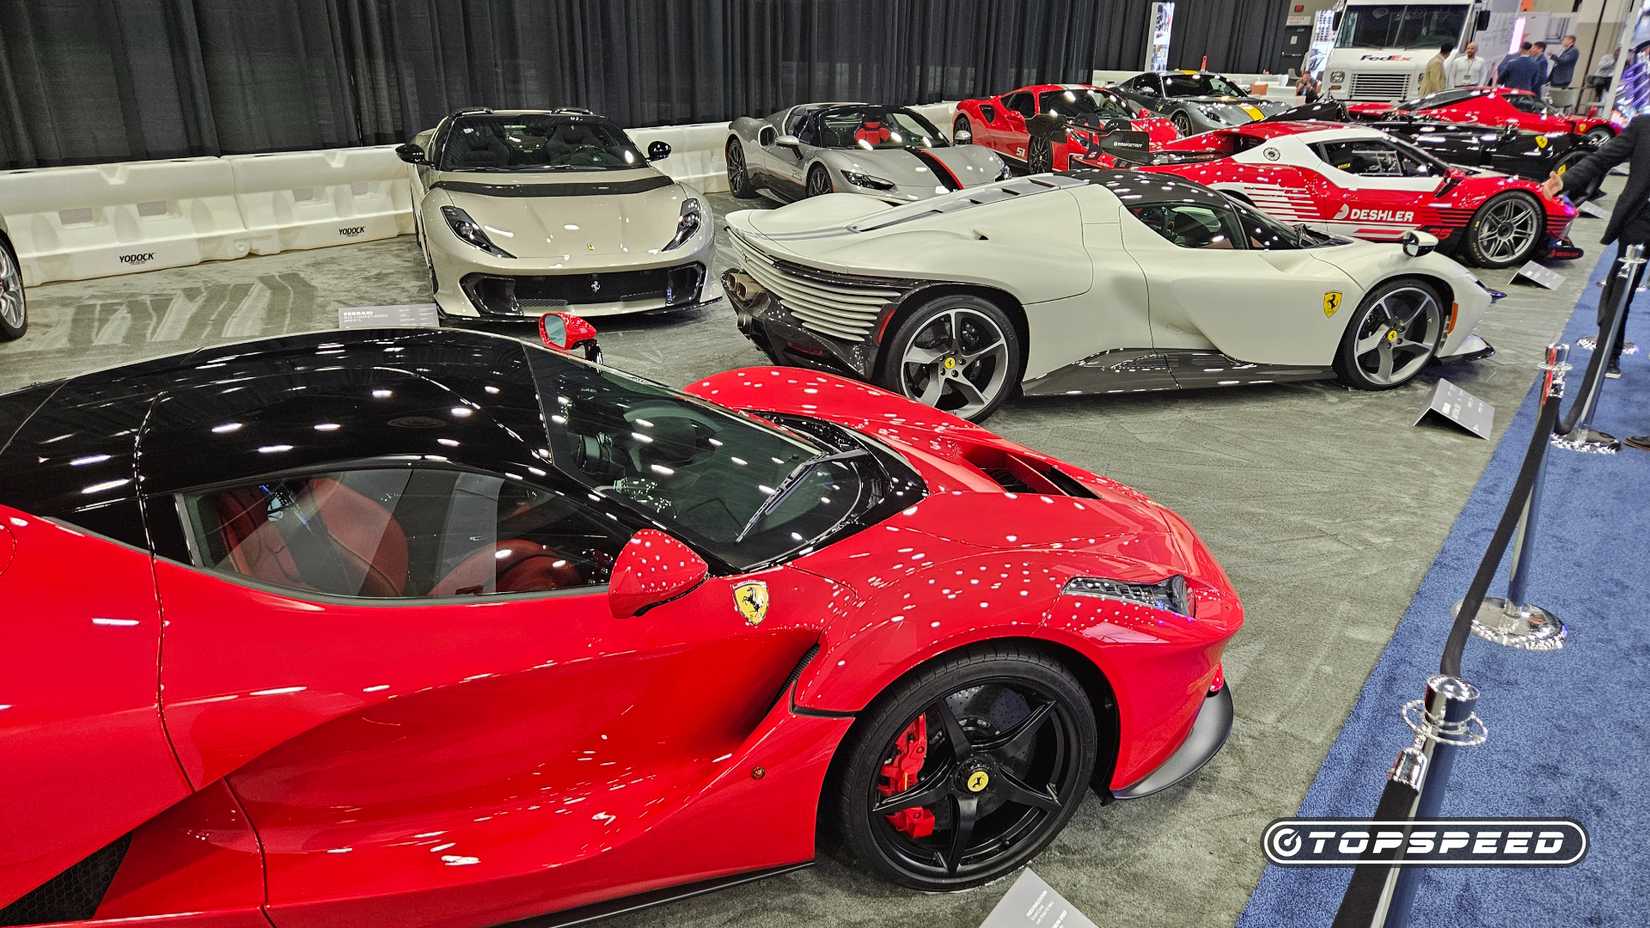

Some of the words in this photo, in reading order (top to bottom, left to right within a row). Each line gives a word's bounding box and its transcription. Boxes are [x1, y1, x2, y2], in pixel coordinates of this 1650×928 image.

[1350, 208, 1414, 222] DESHLER
[338, 226, 365, 235] YODOCK
[119, 253, 154, 263] YODOCK
